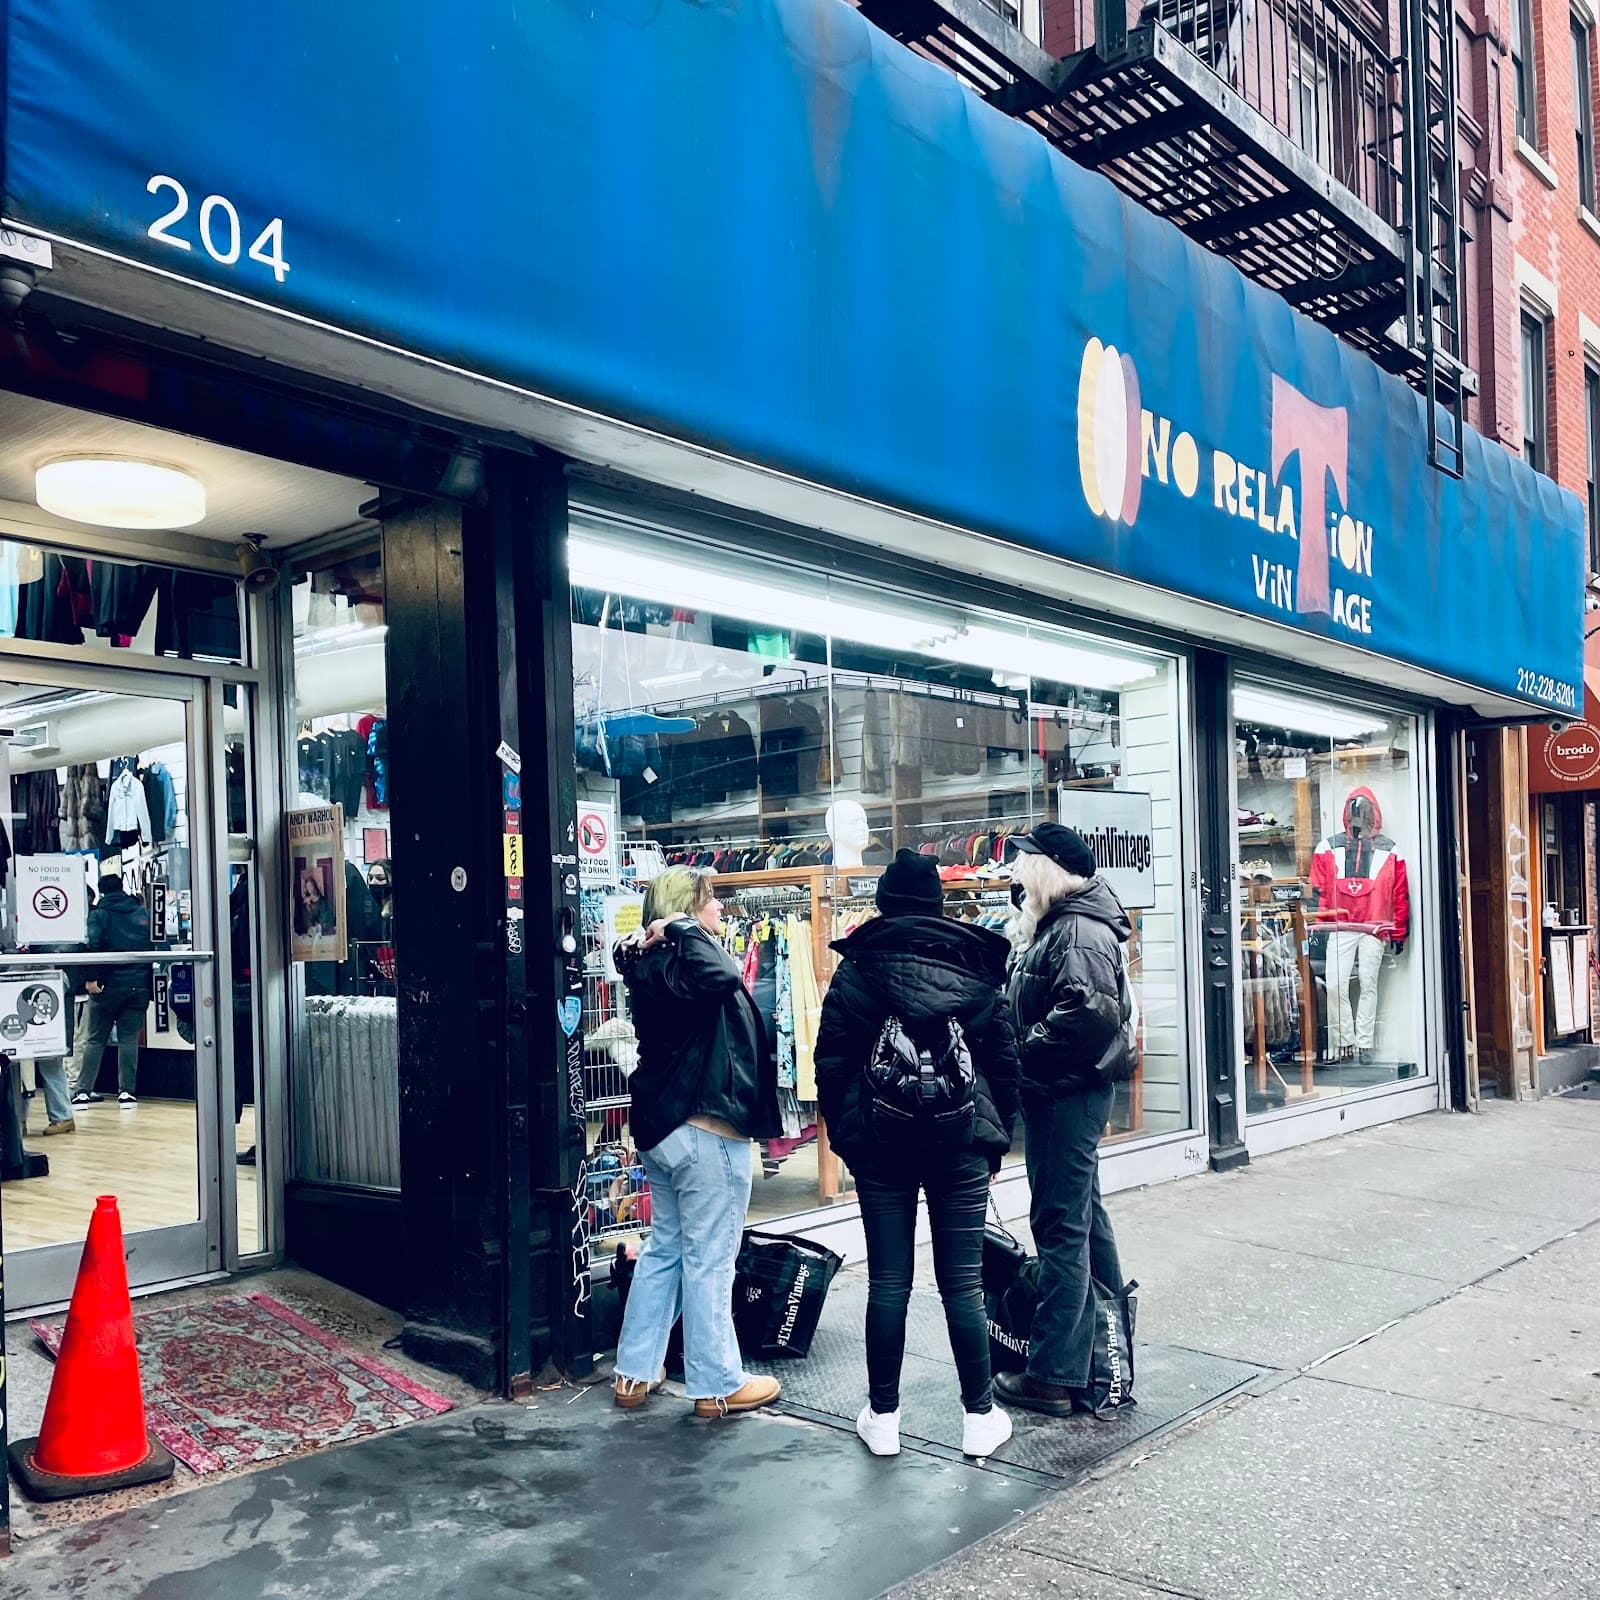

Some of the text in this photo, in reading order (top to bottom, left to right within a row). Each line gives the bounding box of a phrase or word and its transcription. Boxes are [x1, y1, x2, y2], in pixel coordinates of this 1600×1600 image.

[146, 174, 291, 283] 204
[1141, 408, 1199, 498] NO
[1516, 667, 1576, 708] 212-228-5201
[1556, 743, 1594, 756] brodo
[289, 808, 335, 826] ANDY WARHOL
[289, 820, 335, 840] REVELATION
[588, 866, 610, 875] DRINK
[589, 858, 609, 867] FOOD
[1073, 826, 1151, 873] ainVintage
[154, 889, 164, 937] PULL
[156, 980, 167, 1028] PULL
[776, 1263, 810, 1347] #LTrainVintage
[1107, 1309, 1122, 1406] #LTrainVintage
